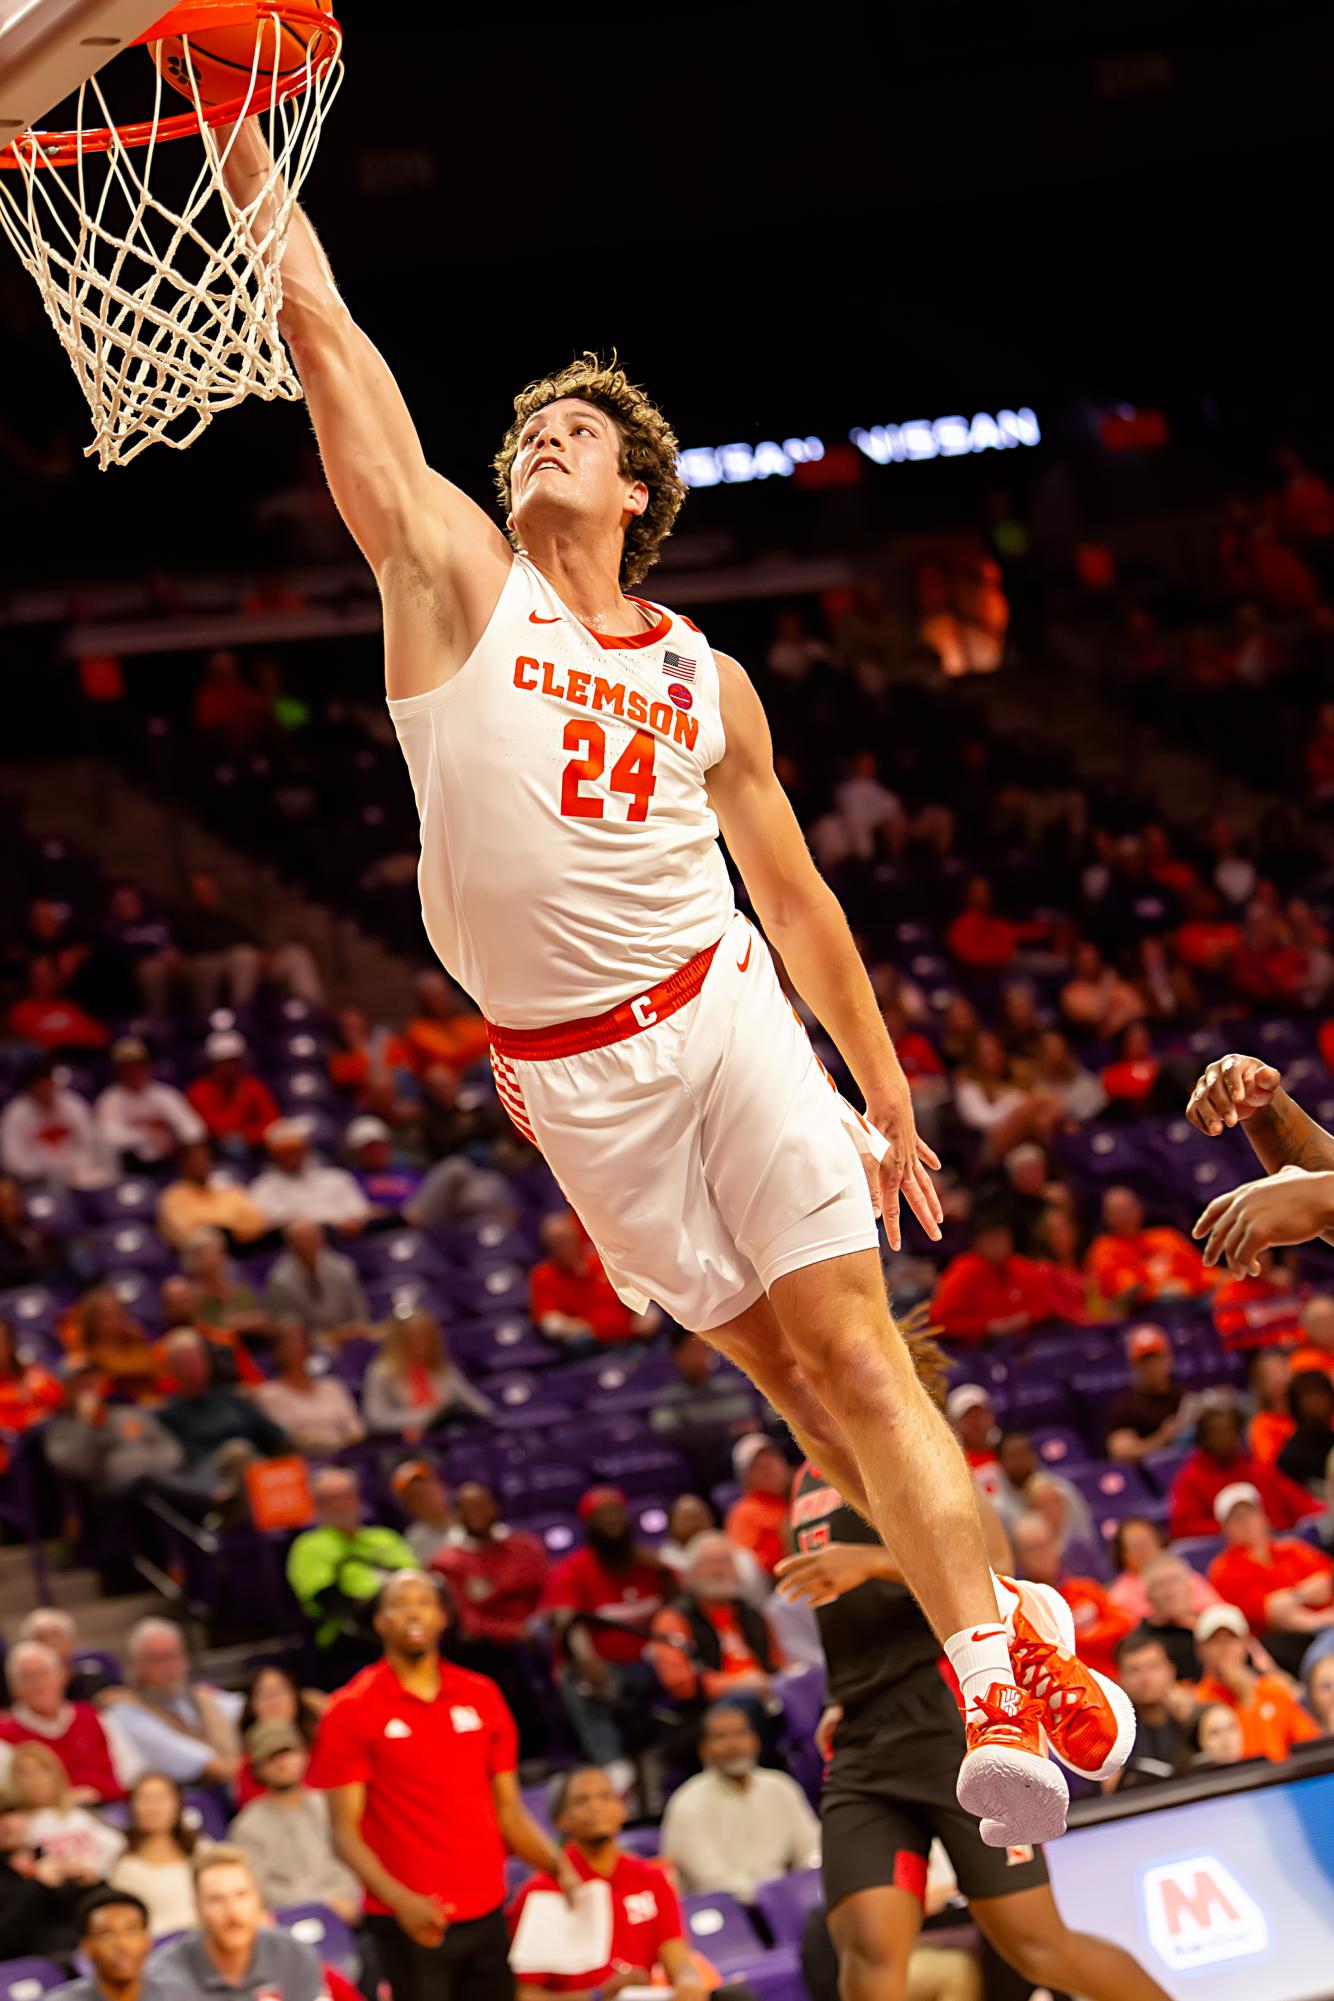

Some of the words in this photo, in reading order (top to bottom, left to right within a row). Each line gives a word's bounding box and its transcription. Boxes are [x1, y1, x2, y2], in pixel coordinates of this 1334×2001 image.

[513, 655, 699, 751] CLEMSON
[560, 719, 657, 822] 24
[631, 995, 657, 1028] C
[1159, 1871, 1241, 1936] M
